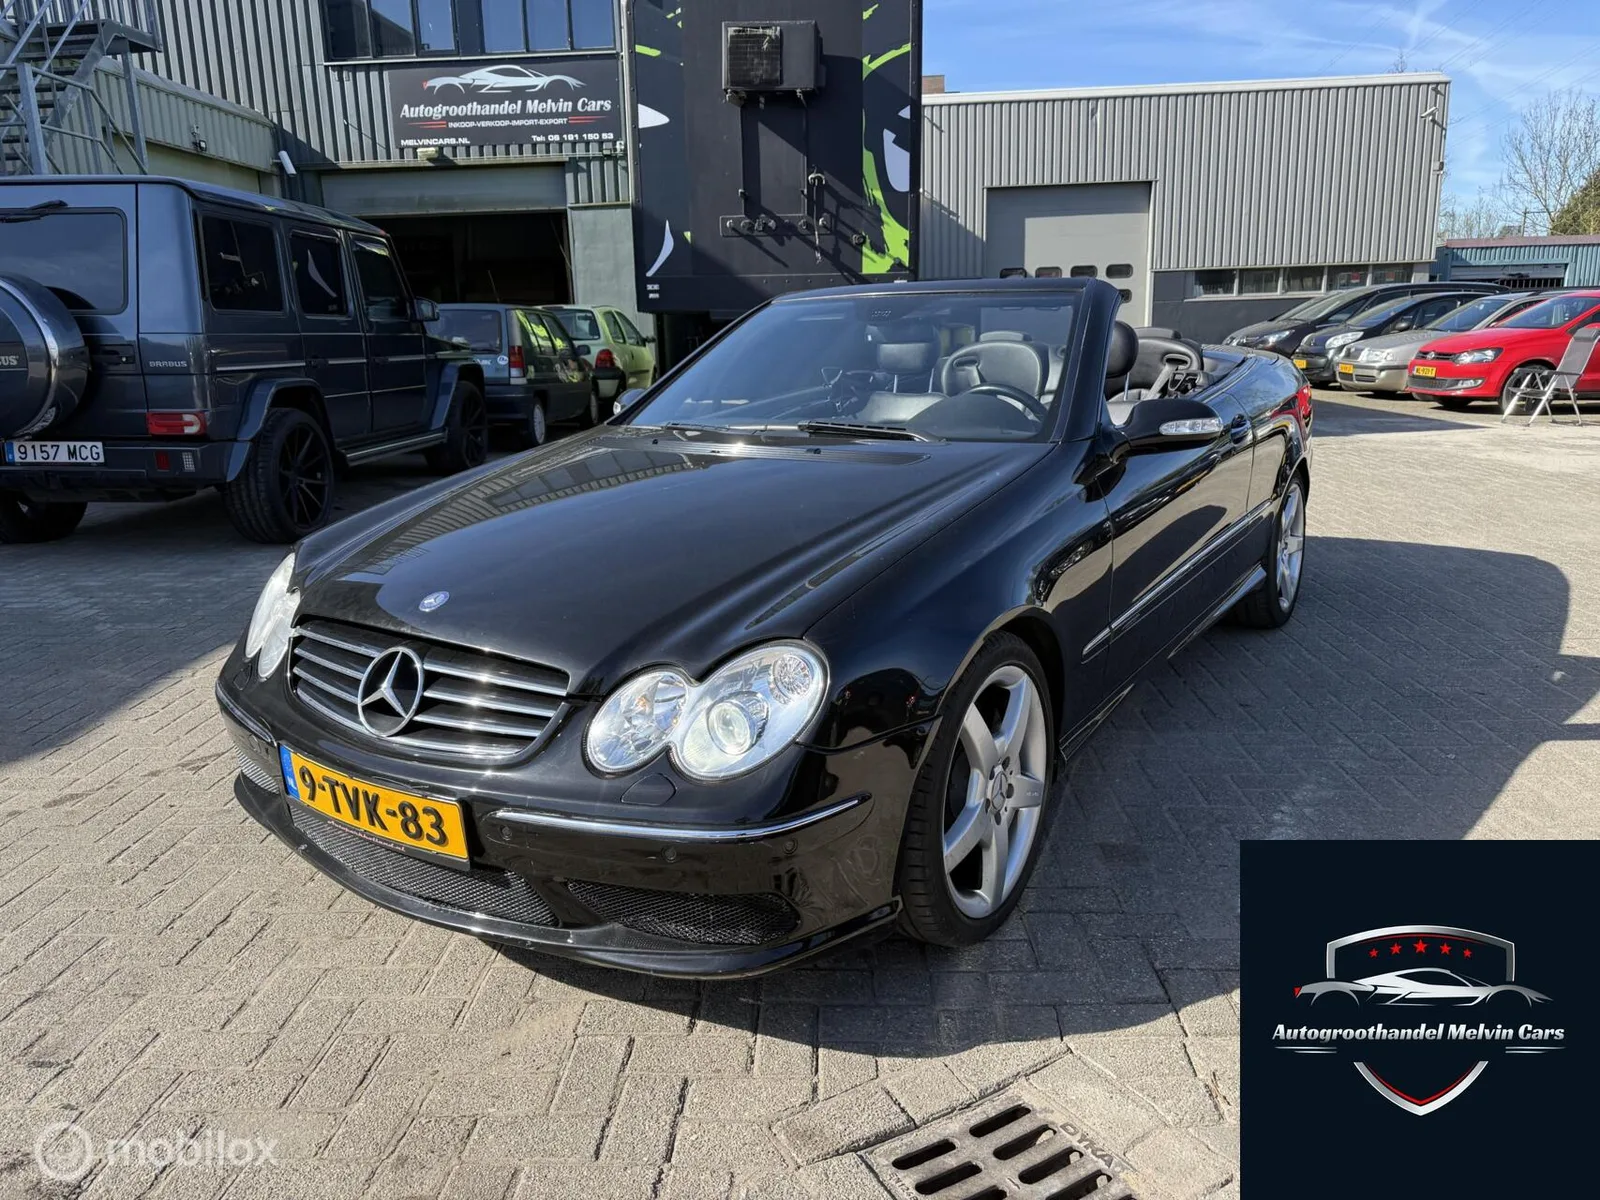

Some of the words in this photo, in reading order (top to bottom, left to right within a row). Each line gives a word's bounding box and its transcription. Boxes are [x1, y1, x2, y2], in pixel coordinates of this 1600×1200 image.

[400, 100, 521, 119] Autogroothandel
[525, 98, 572, 114] Melvin
[577, 97, 612, 112] Cars
[400, 137, 471, 146] MELVINCARS.NL
[0, 355, 17, 366] US
[17, 444, 60, 461] 9157
[67, 444, 100, 461] MCG
[299, 765, 448, 847] 9-TVK-83
